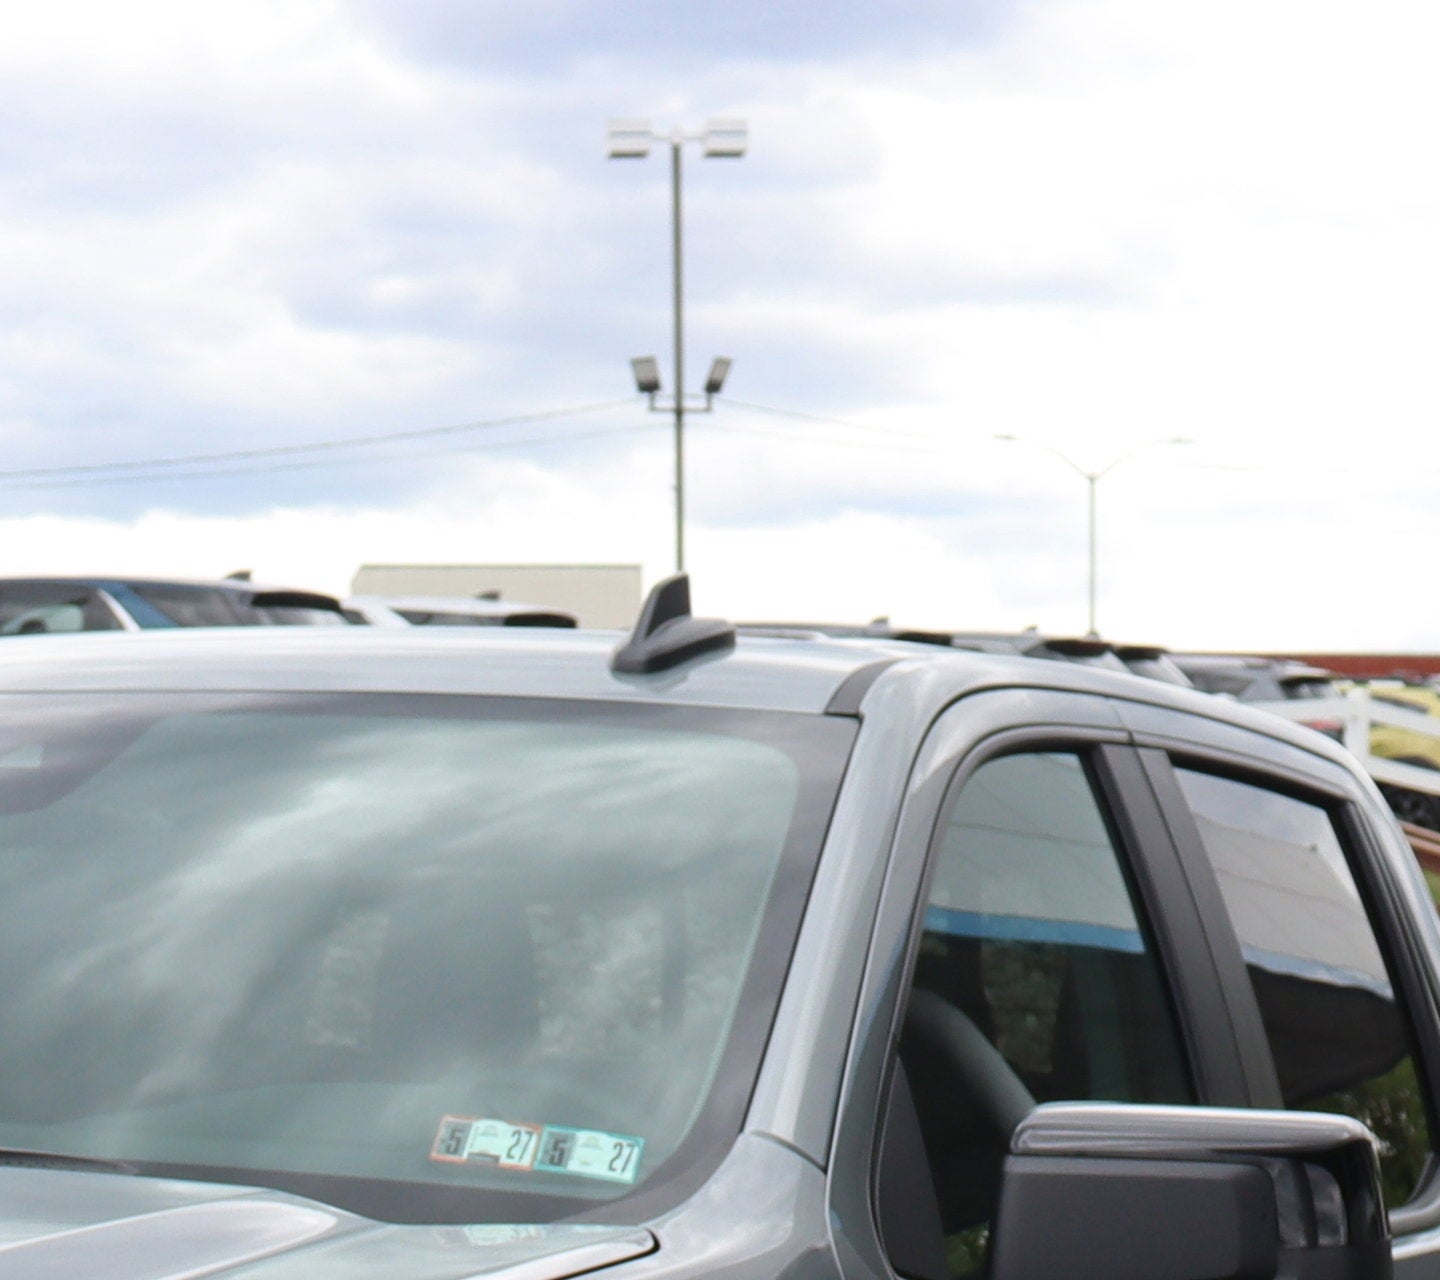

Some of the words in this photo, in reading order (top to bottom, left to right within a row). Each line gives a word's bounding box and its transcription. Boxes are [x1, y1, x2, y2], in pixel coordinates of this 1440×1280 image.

[445, 1128, 464, 1156] 5
[505, 1129, 535, 1163] 27
[548, 1138, 568, 1166] 5
[607, 1141, 636, 1173] 27
